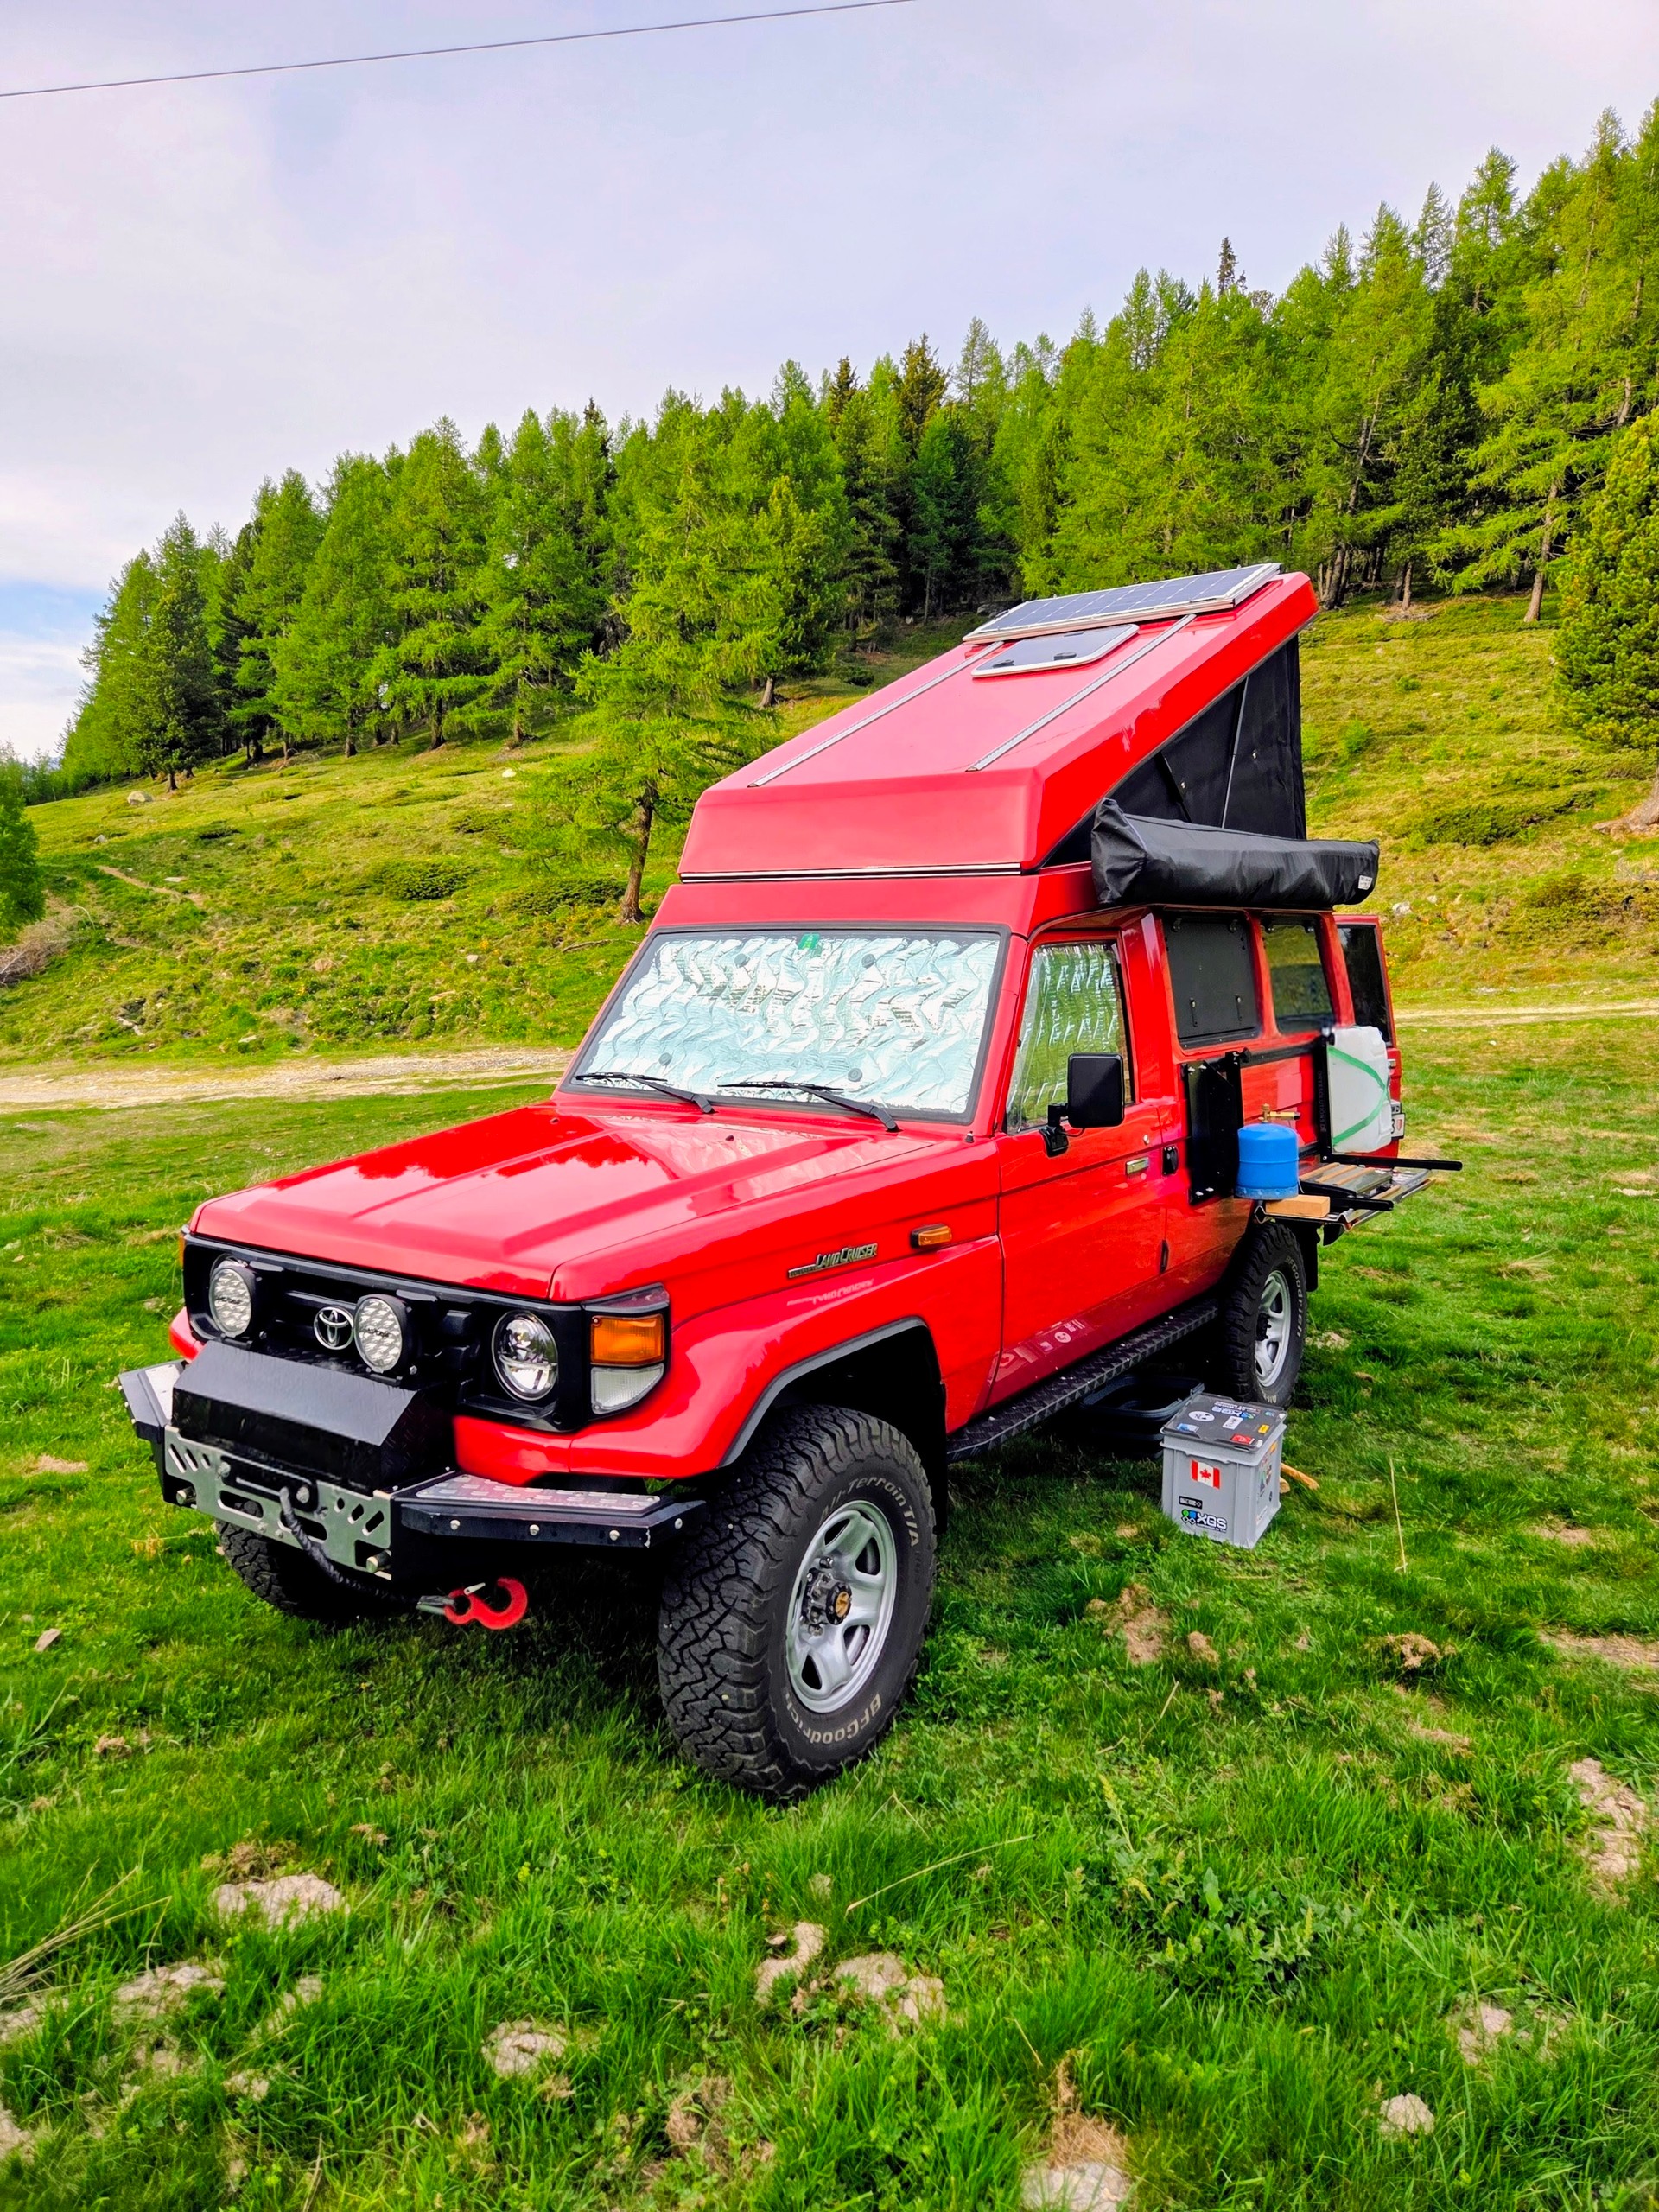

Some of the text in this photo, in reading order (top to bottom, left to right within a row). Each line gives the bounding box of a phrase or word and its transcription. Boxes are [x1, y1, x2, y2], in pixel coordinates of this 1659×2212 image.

[840, 1243, 878, 1263] CRUISER
[1285, 1255, 1303, 1338] BFGoodrich
[903, 1505, 920, 1548] T/A
[1197, 1512, 1227, 1529] XGS
[785, 1691, 882, 1745] BFGoodrich
